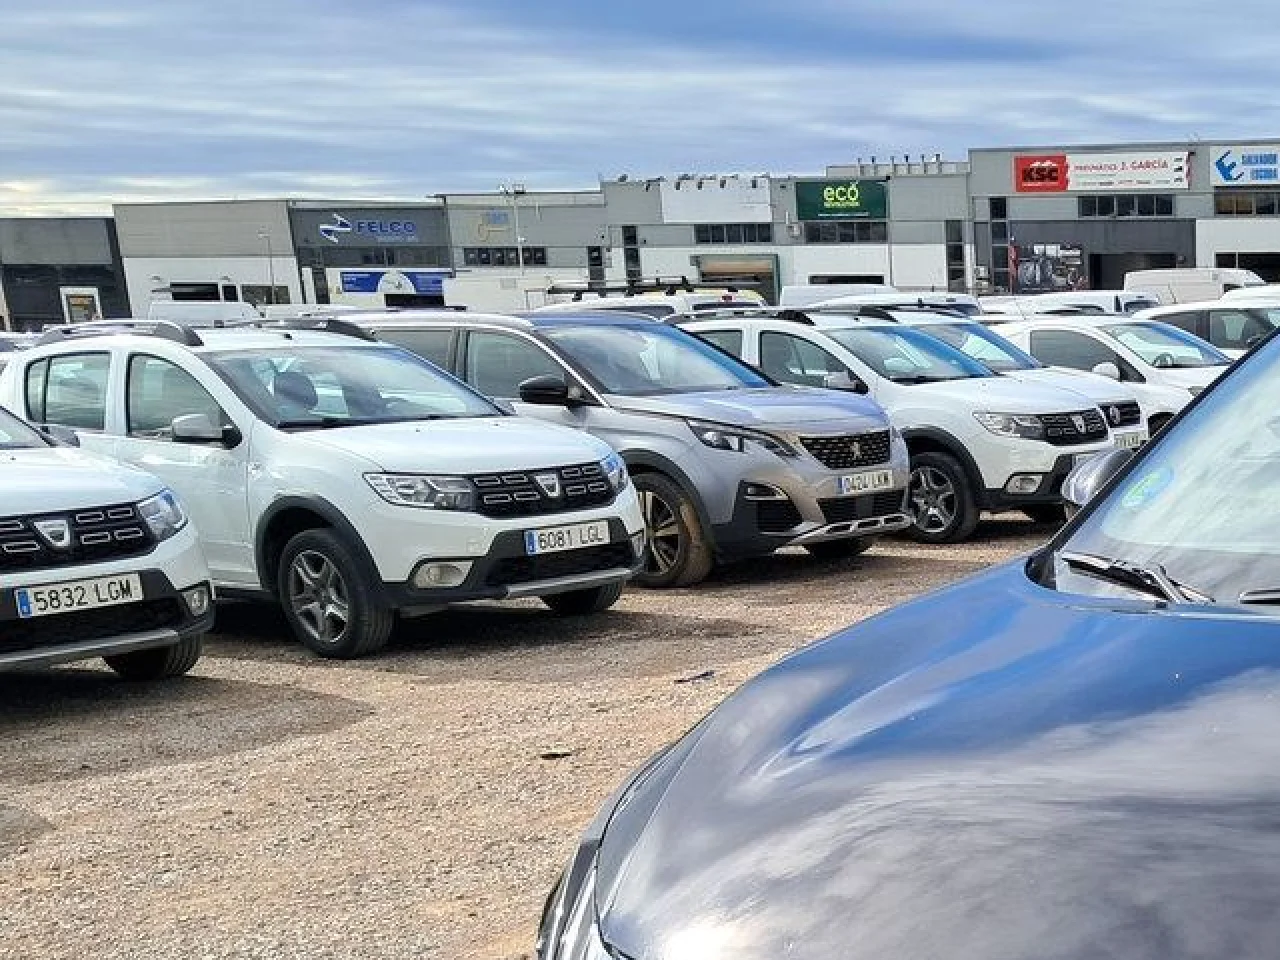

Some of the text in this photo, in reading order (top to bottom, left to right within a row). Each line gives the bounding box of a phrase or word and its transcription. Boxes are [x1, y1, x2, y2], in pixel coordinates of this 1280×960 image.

[1021, 167, 1059, 182] KSC
[357, 221, 417, 233] FELCO
[538, 526, 604, 551] 6081 LGL
[33, 579, 133, 611] 5832 LGM
